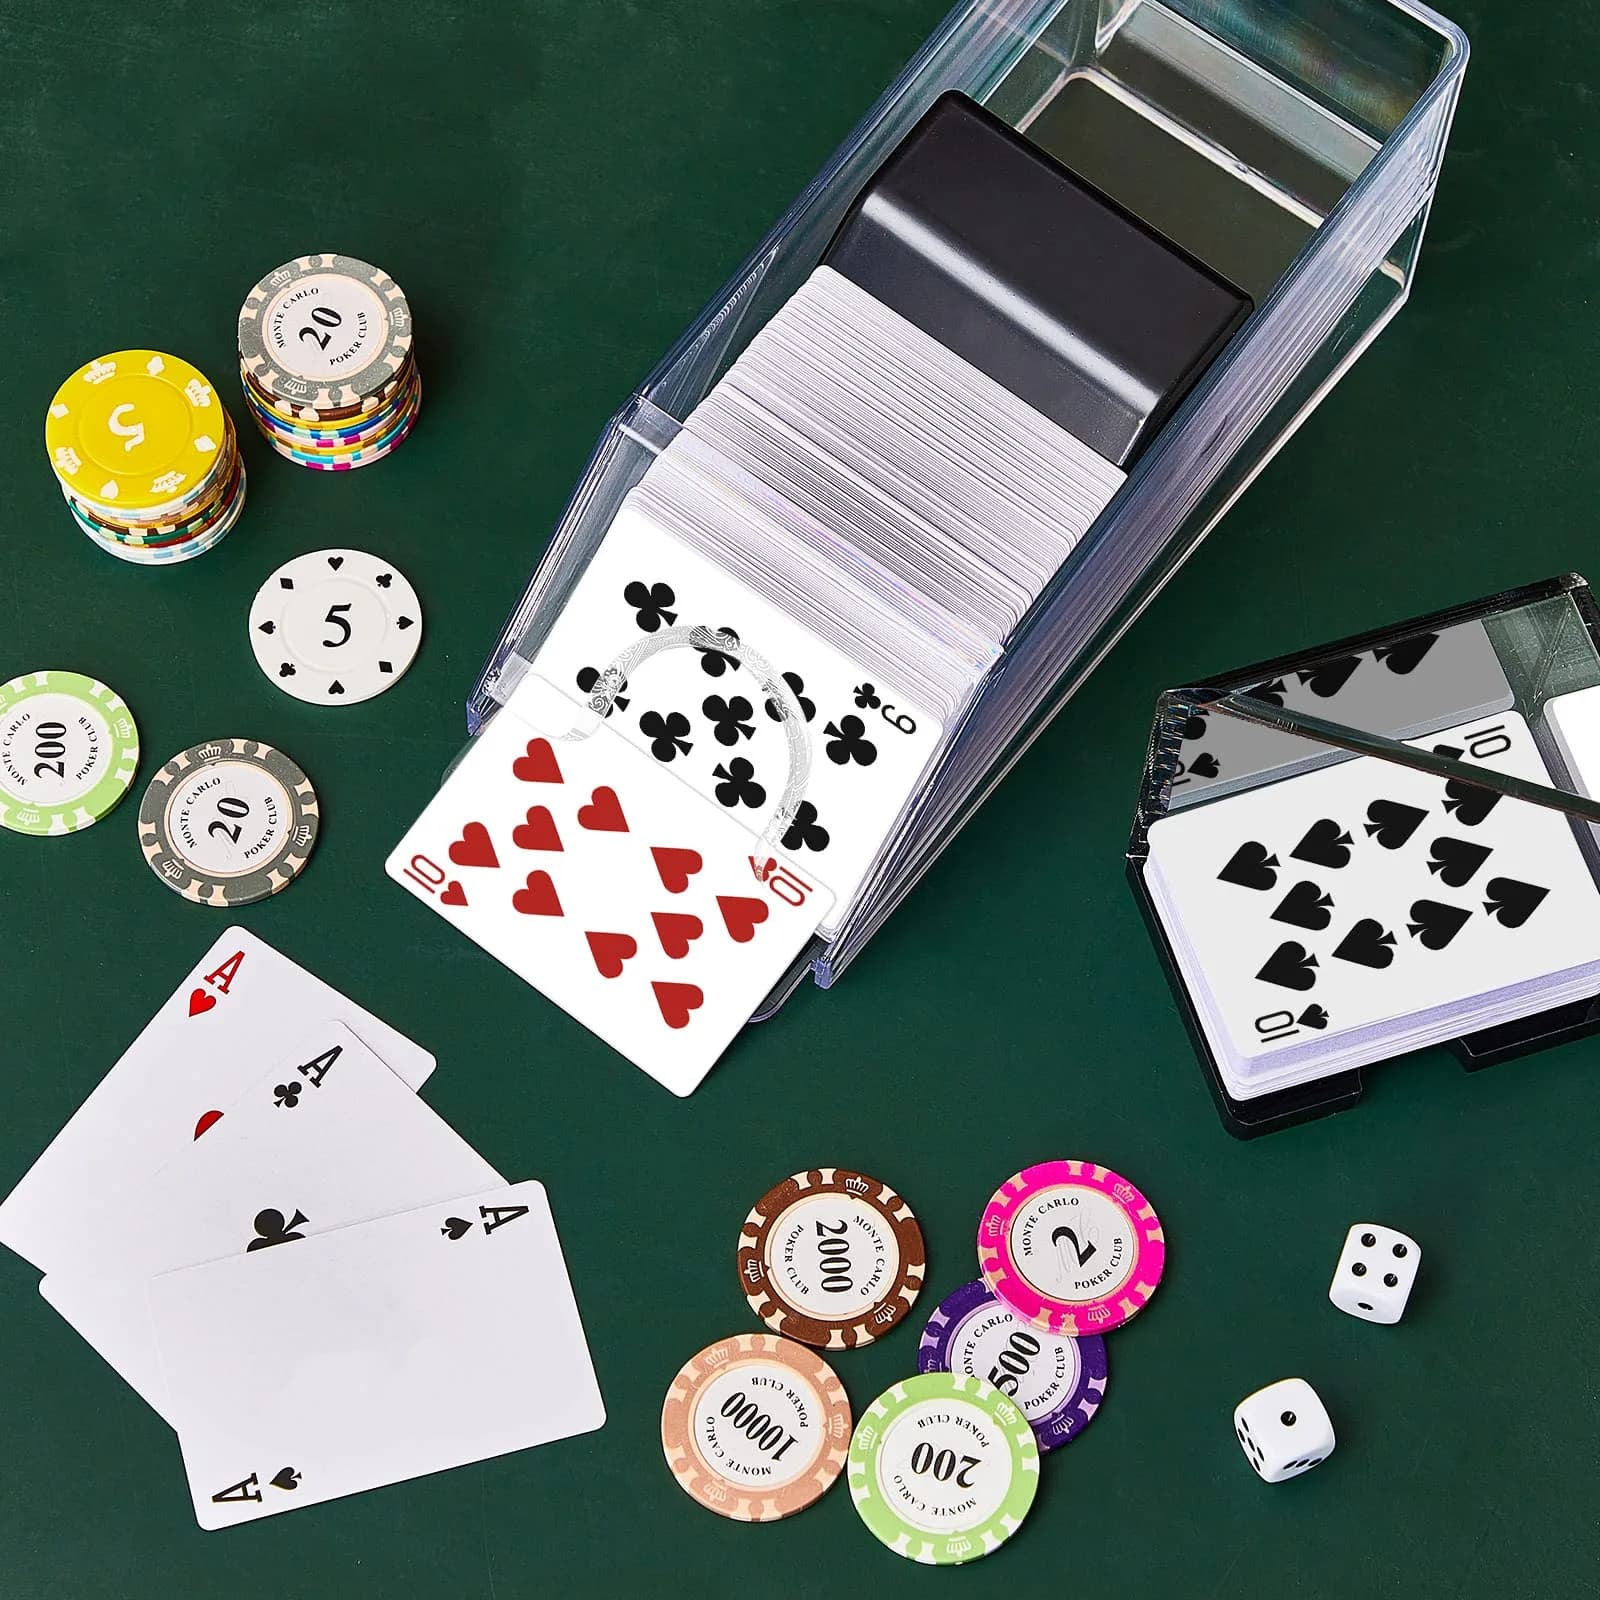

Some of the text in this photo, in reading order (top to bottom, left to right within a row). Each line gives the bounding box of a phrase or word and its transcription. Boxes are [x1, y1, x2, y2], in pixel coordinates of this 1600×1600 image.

[273, 288, 319, 348] MONTE CARLO
[299, 307, 342, 351] 20
[329, 312, 367, 365] POKER CLUB
[108, 403, 145, 452] 5
[323, 603, 352, 648] 5
[2, 713, 31, 786] MONTE CARLO
[34, 722, 67, 778] 200
[75, 717, 98, 780] POKER CLUB
[1464, 724, 1511, 759] 10
[180, 777, 221, 848] MONTE CARLO
[208, 797, 250, 844] 20
[244, 797, 277, 859] POKER CLUB
[402, 853, 446, 894] 10
[769, 866, 813, 907] 10
[204, 950, 245, 995] A
[1254, 1009, 1300, 1043] 10
[297, 1045, 343, 1088] A
[479, 1205, 529, 1235] A
[1022, 1197, 1079, 1257] MONTE CARLO
[784, 1224, 809, 1295] POKER CLUB
[816, 1219, 853, 1293] 2000
[853, 1215, 885, 1296] MONTE CARLO
[1052, 1226, 1097, 1268] 2
[1074, 1237, 1123, 1290] POKER CLUB
[963, 1313, 1013, 1377] ONTE CARLO
[987, 1332, 1040, 1397] 500
[752, 1377, 809, 1428] POKER CLUB
[1024, 1346, 1066, 1410] POKER CLUB
[706, 1416, 771, 1476] MONTE CARLO
[721, 1392, 799, 1461] 10000
[917, 1414, 989, 1448] POKER CLUB
[212, 1472, 263, 1504] A
[911, 1442, 982, 1488] 200
[894, 1475, 976, 1516] MONTE CARLO
